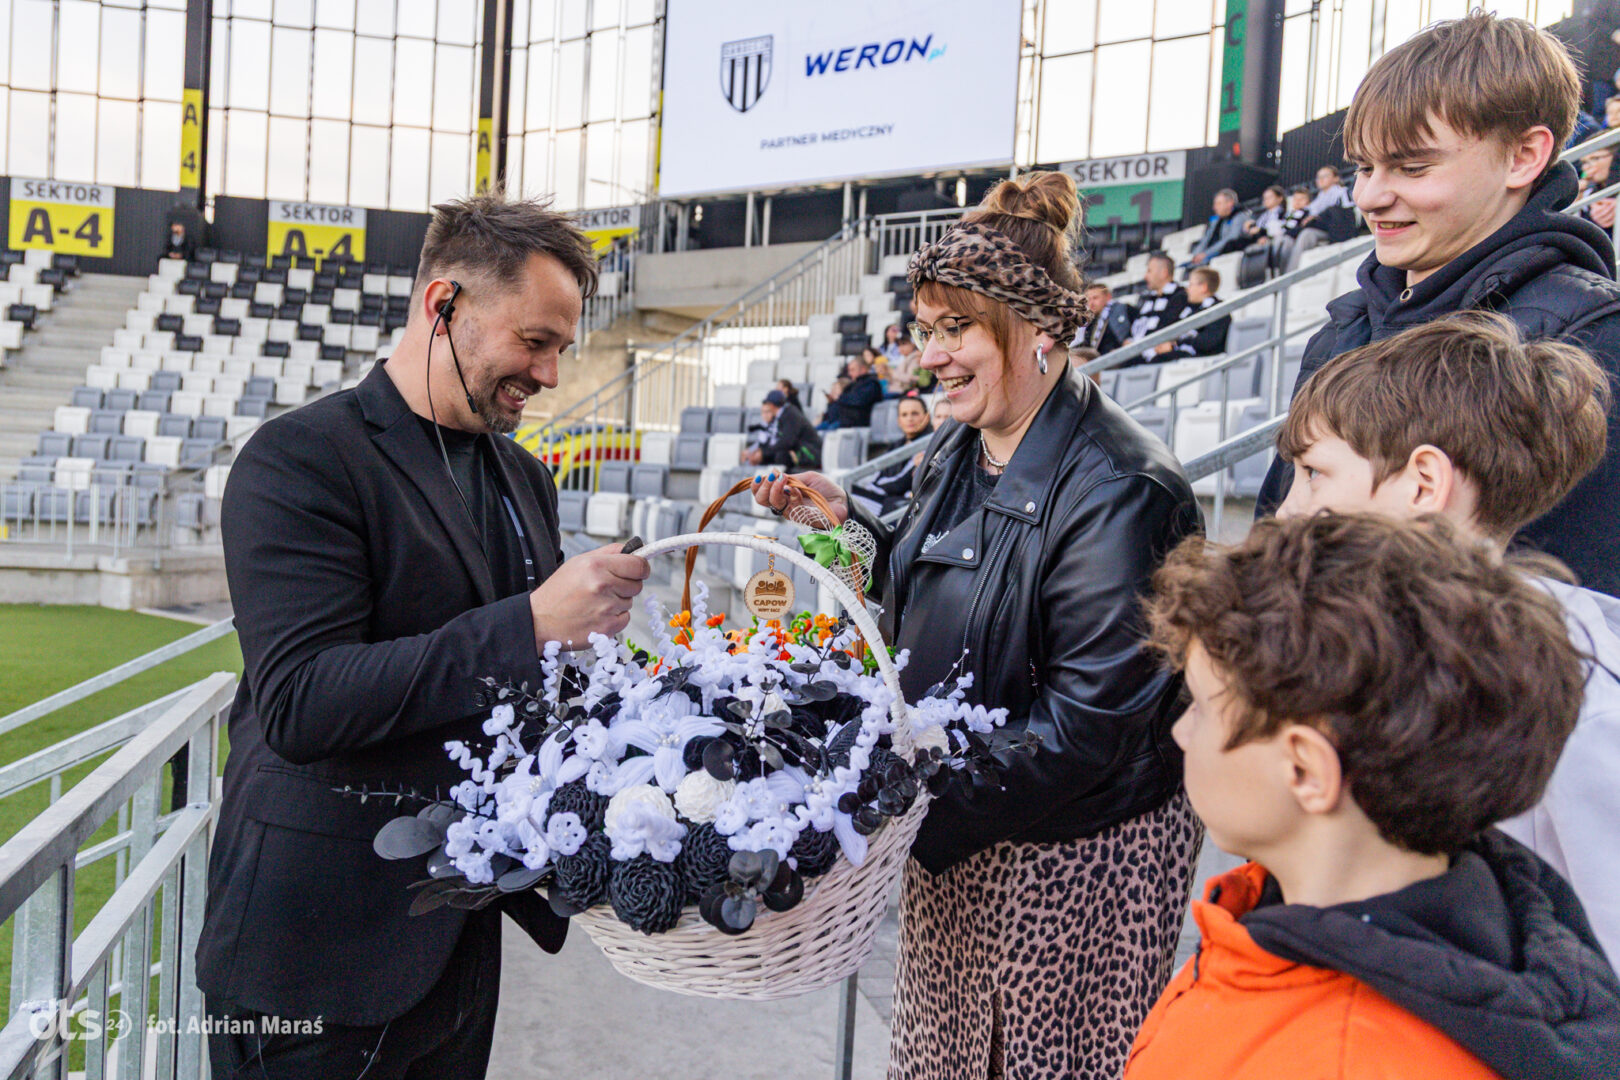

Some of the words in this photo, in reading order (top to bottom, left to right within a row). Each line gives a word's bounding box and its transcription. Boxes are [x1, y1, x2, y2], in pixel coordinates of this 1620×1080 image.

[804, 33, 933, 77] WERON
[183, 103, 198, 126] A
[477, 131, 490, 153] A
[760, 132, 818, 149] PARTNER
[821, 123, 895, 143] MEDYCZNY
[182, 151, 196, 173] 4
[1073, 156, 1168, 184] SEKTOR
[24, 181, 103, 204] SEKTOR
[280, 203, 354, 223] SEKTOR
[22, 207, 103, 249] A-4
[282, 228, 354, 260] A-4
[753, 599, 787, 607] CAPOW
